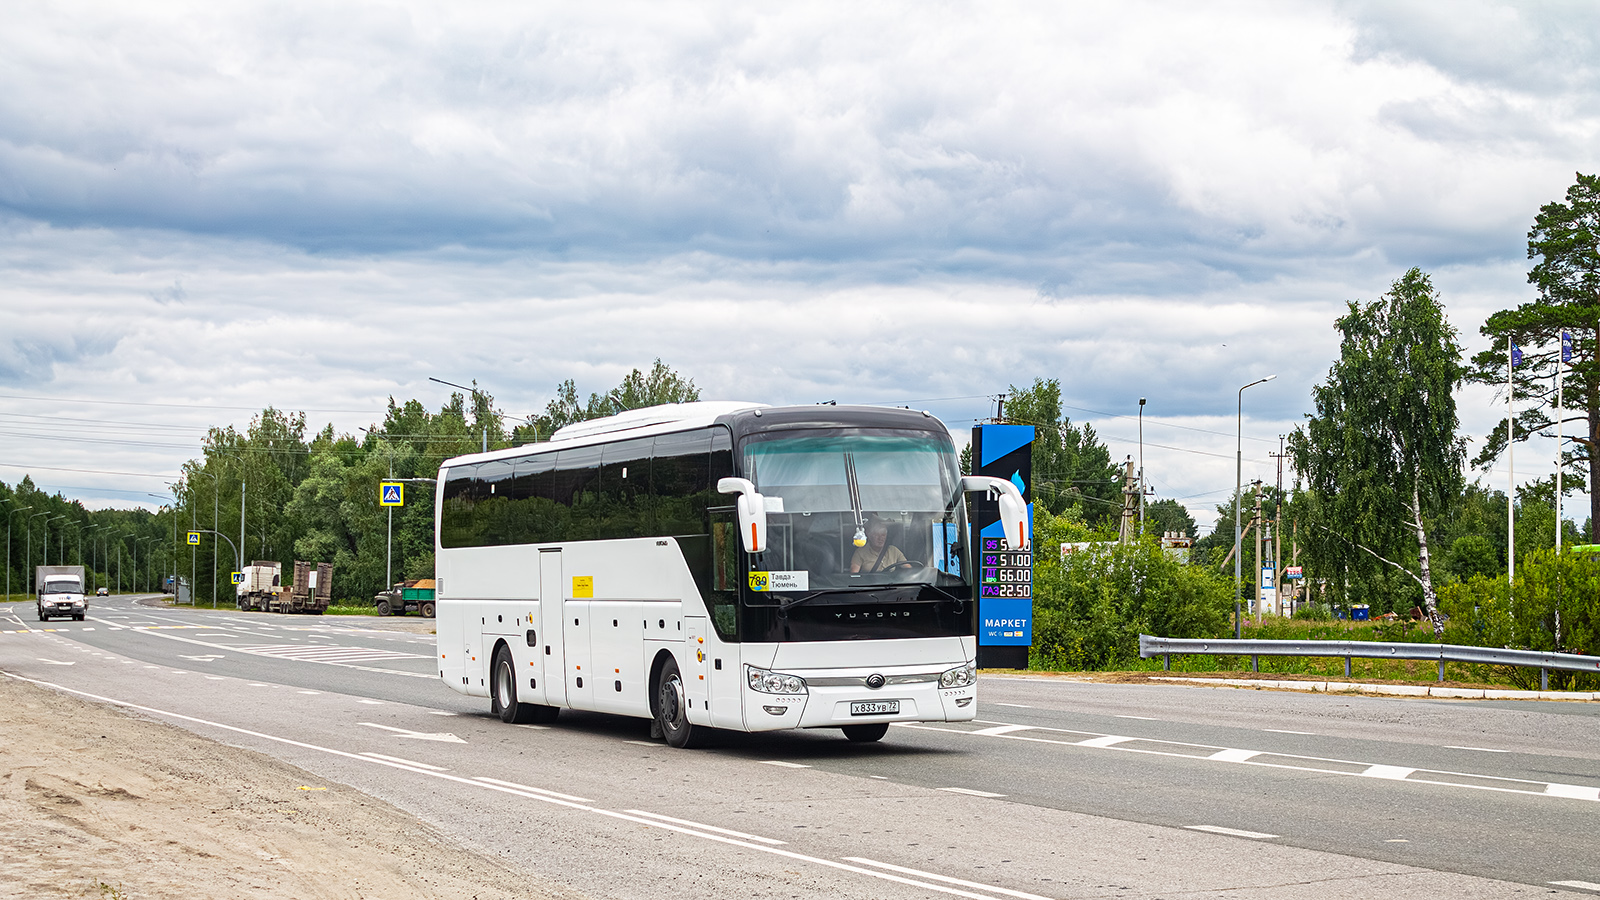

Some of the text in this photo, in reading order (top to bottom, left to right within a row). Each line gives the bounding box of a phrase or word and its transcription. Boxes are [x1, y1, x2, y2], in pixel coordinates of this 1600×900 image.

[986, 540, 998, 549] 95
[986, 554, 1030, 567] 92 51.00
[986, 568, 1030, 582] ДТ 66.00
[982, 584, 1030, 597] ГАЗ 22.50
[835, 611, 910, 619] YUTONG
[985, 618, 1027, 628] МАРКЕТ
